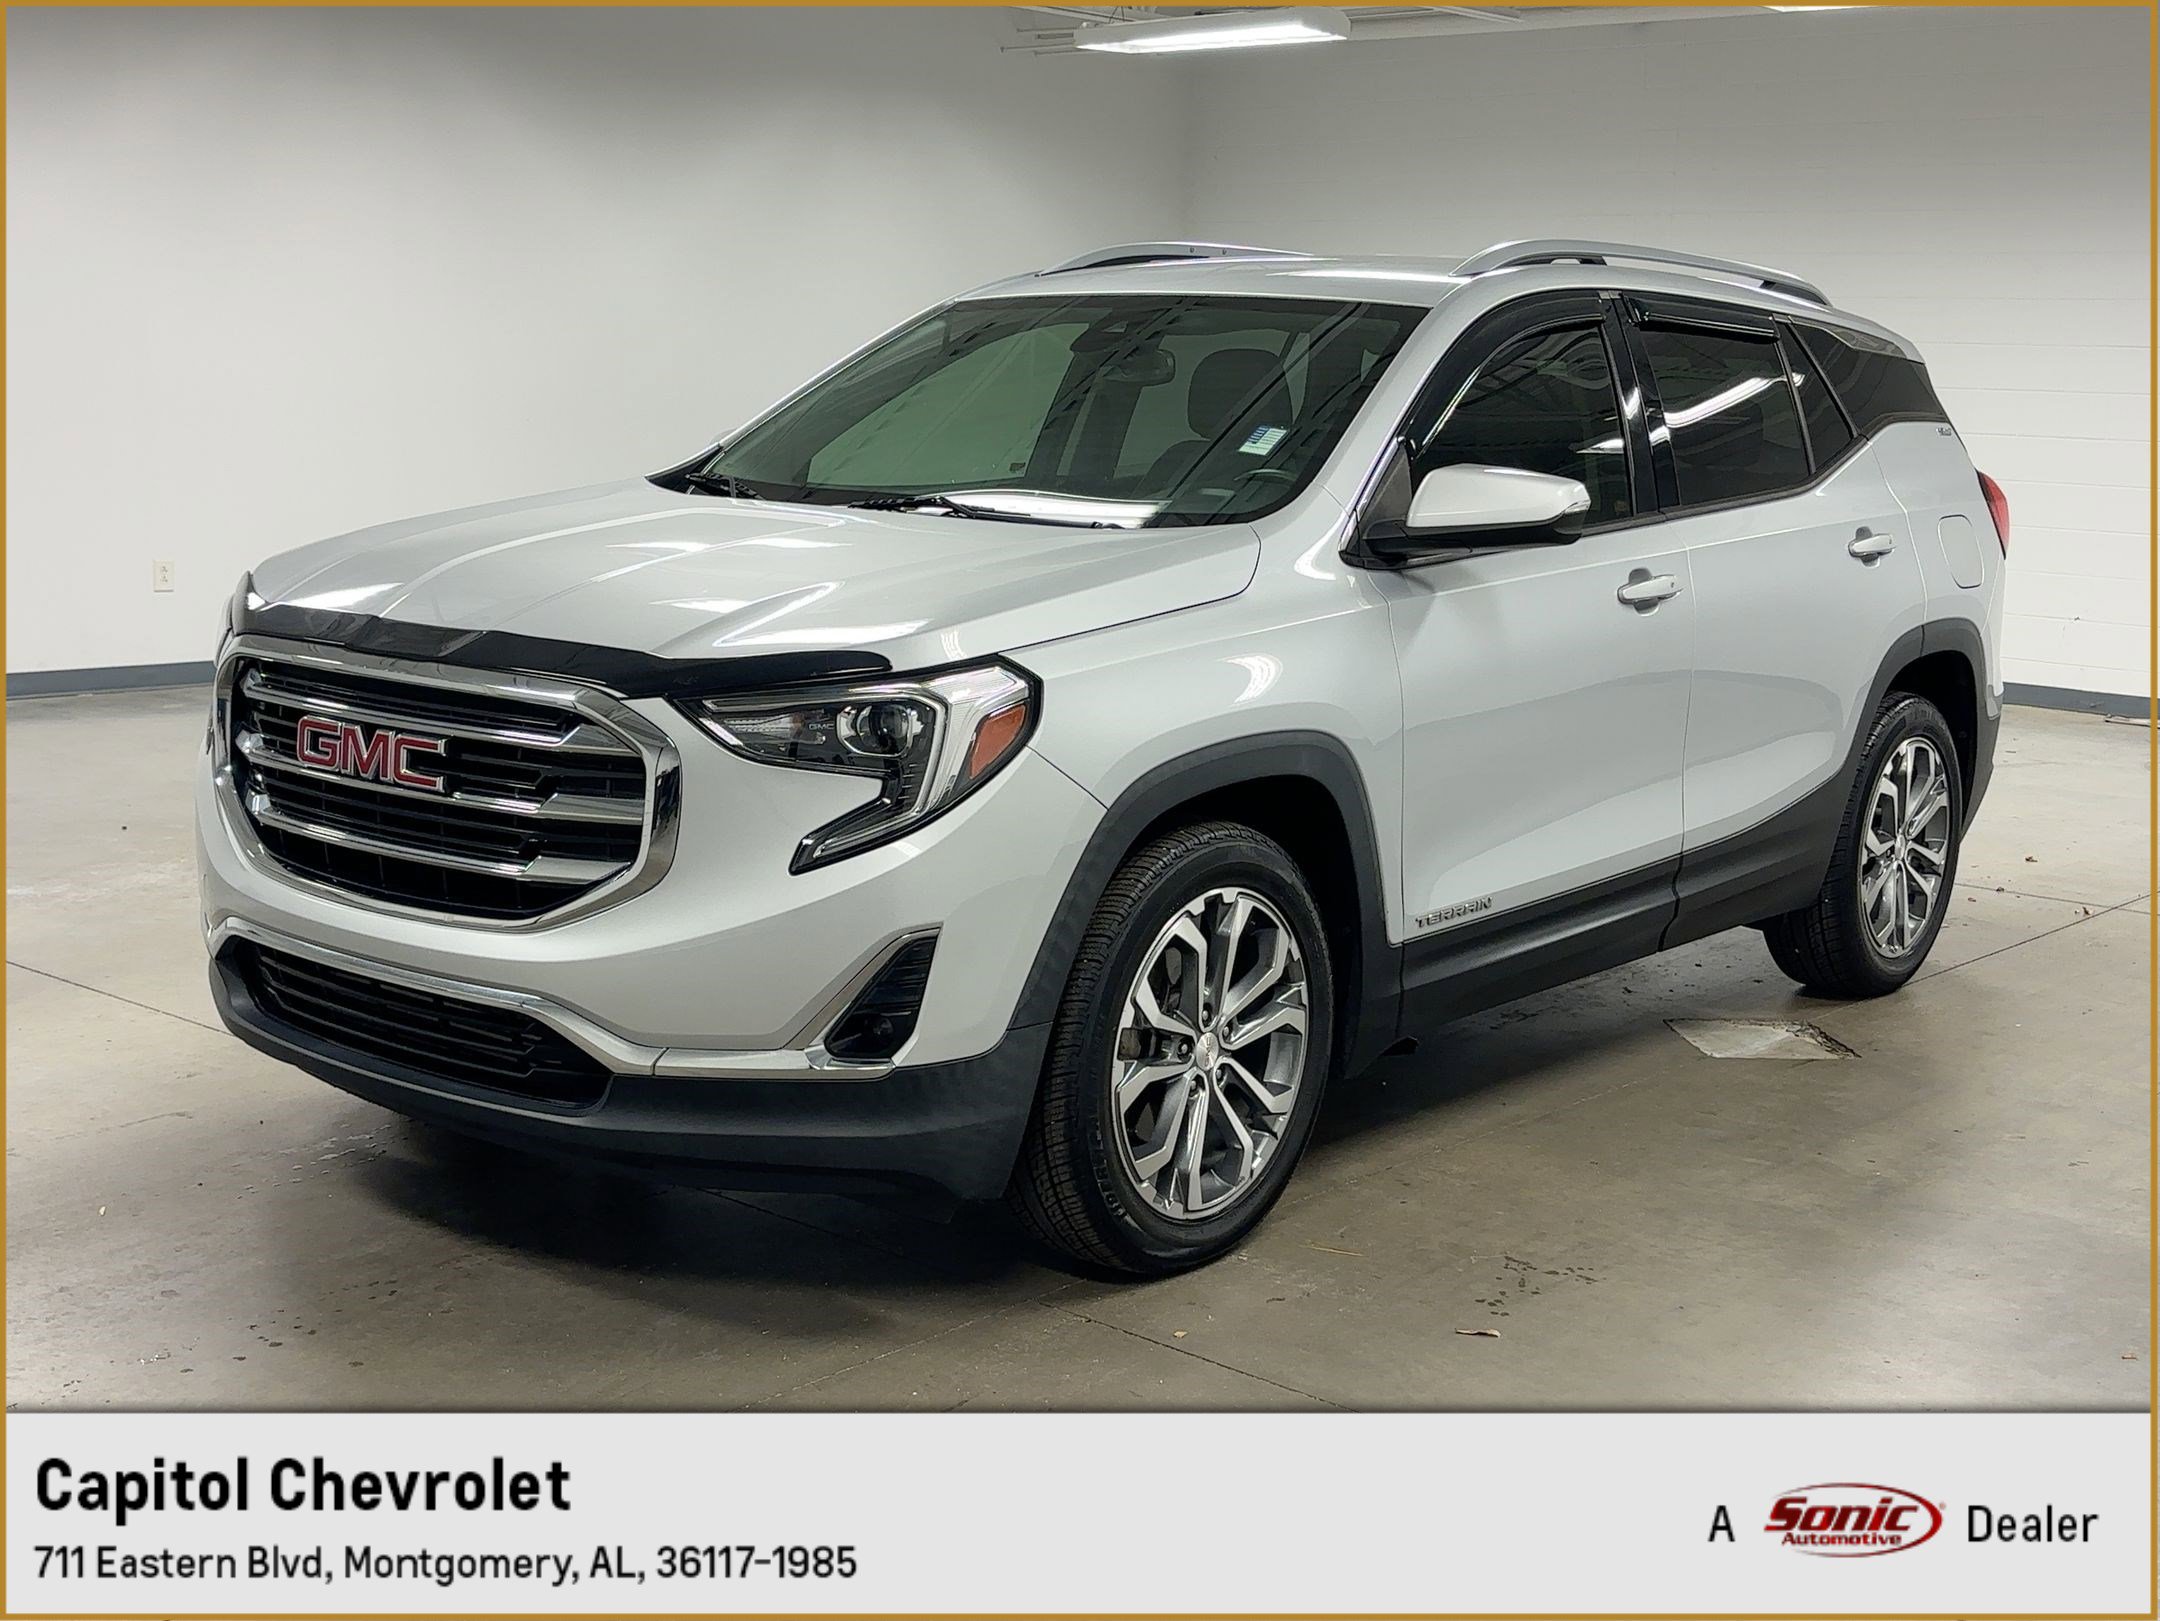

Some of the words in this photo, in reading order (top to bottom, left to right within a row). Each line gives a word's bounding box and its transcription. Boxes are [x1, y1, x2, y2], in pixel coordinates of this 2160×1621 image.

[808, 722, 835, 731] GMC
[296, 714, 449, 793] GMC
[1415, 896, 1493, 928] TERRAIN
